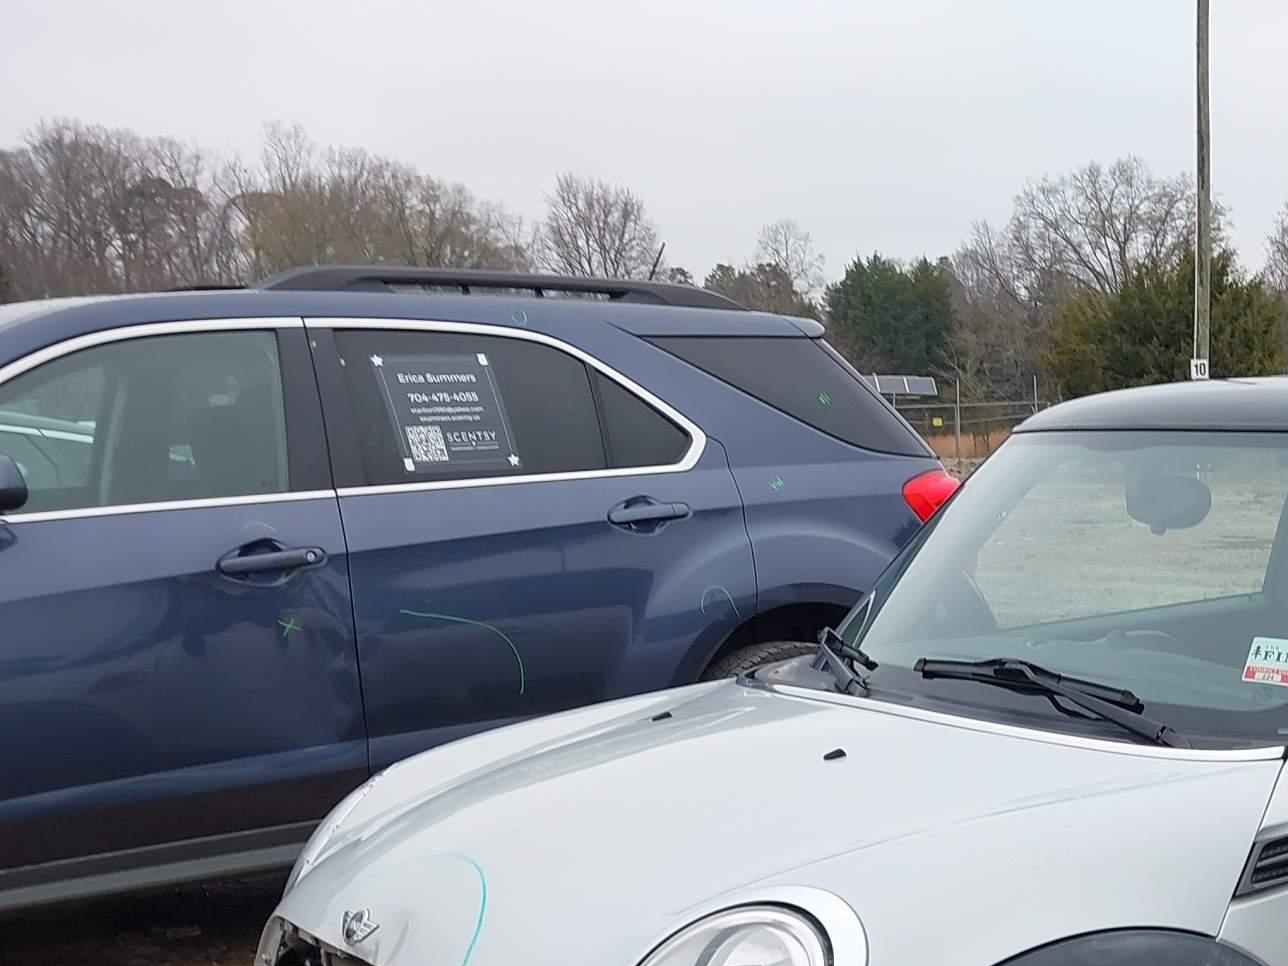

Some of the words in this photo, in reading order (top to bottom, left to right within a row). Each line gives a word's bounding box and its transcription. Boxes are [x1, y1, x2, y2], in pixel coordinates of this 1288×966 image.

[1194, 362, 1206, 376] 10
[397, 373, 425, 383] Erica
[426, 372, 477, 383] Summers
[446, 430, 496, 442] SCENTSY
